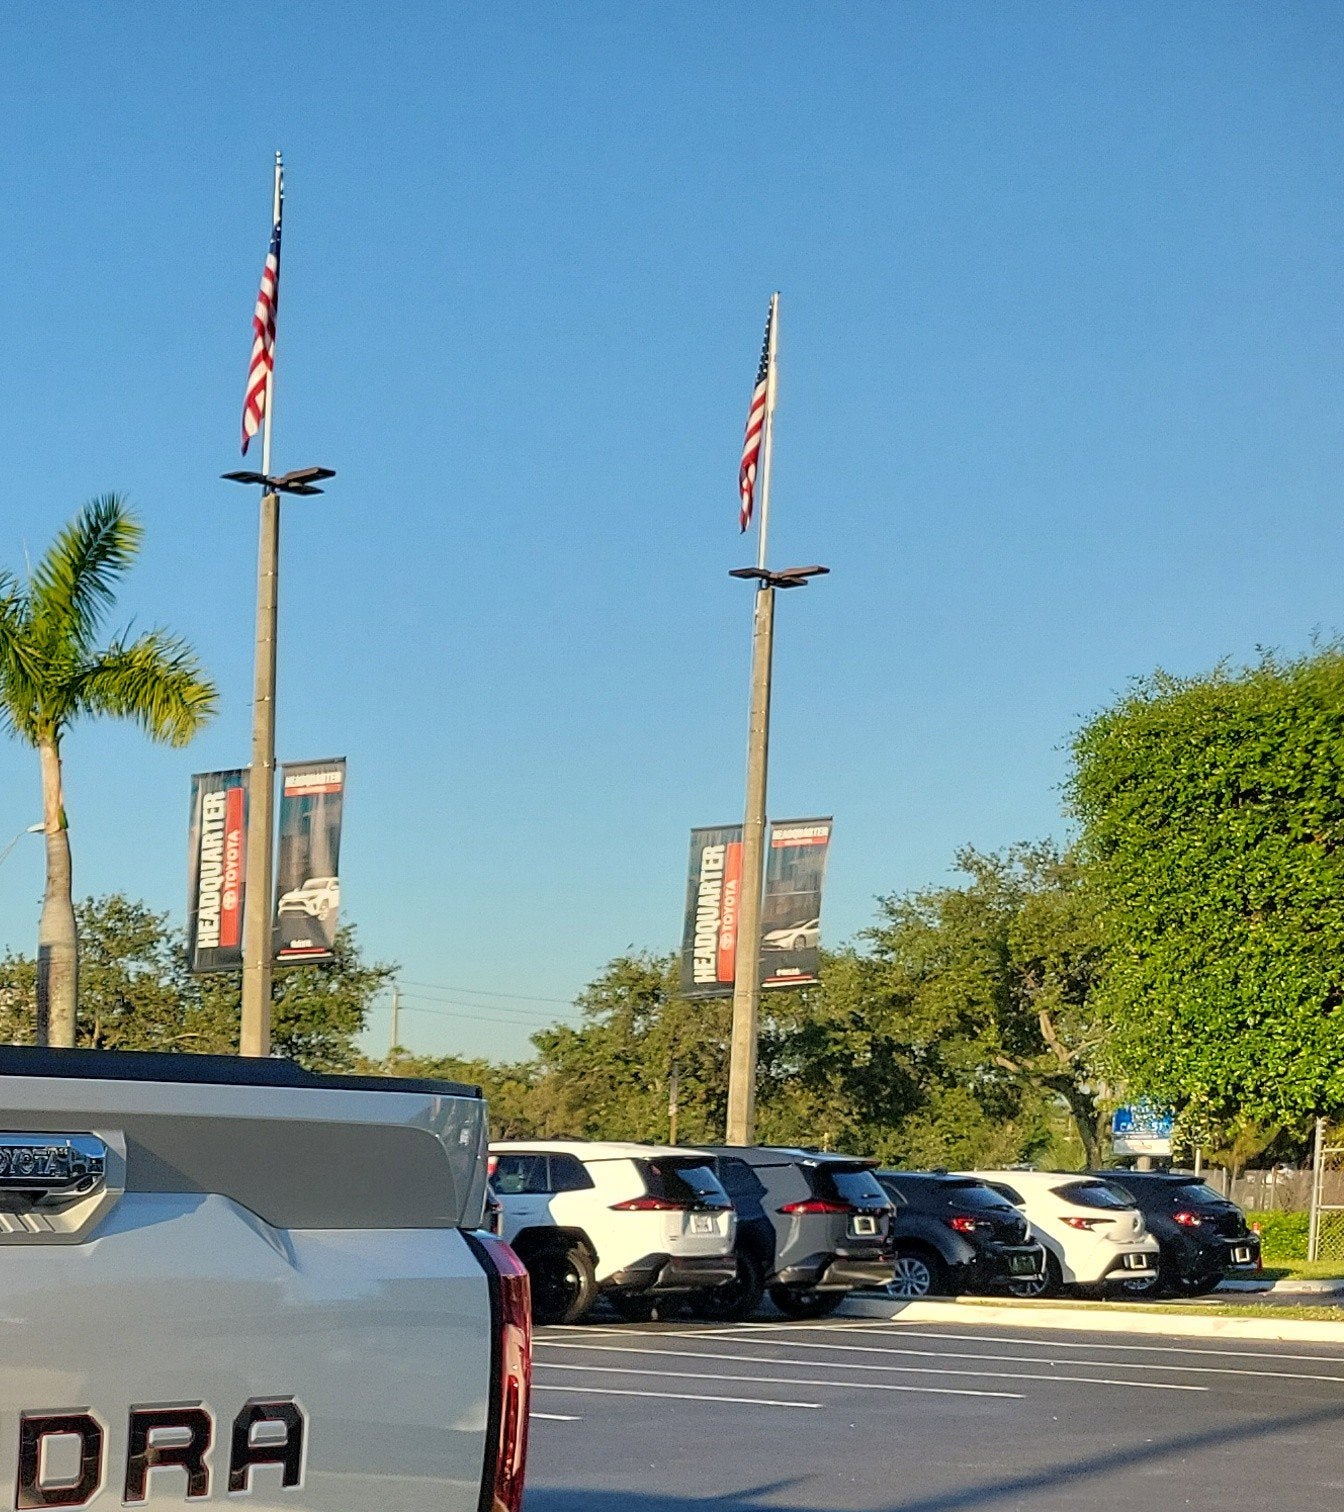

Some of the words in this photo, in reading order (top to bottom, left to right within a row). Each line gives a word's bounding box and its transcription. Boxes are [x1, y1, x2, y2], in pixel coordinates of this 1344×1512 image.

[197, 790, 226, 949] HEADQUARTER
[224, 829, 241, 893] TOYOTA
[722, 879, 738, 932] TOYOTA
[694, 844, 725, 984] HEADQUARTER
